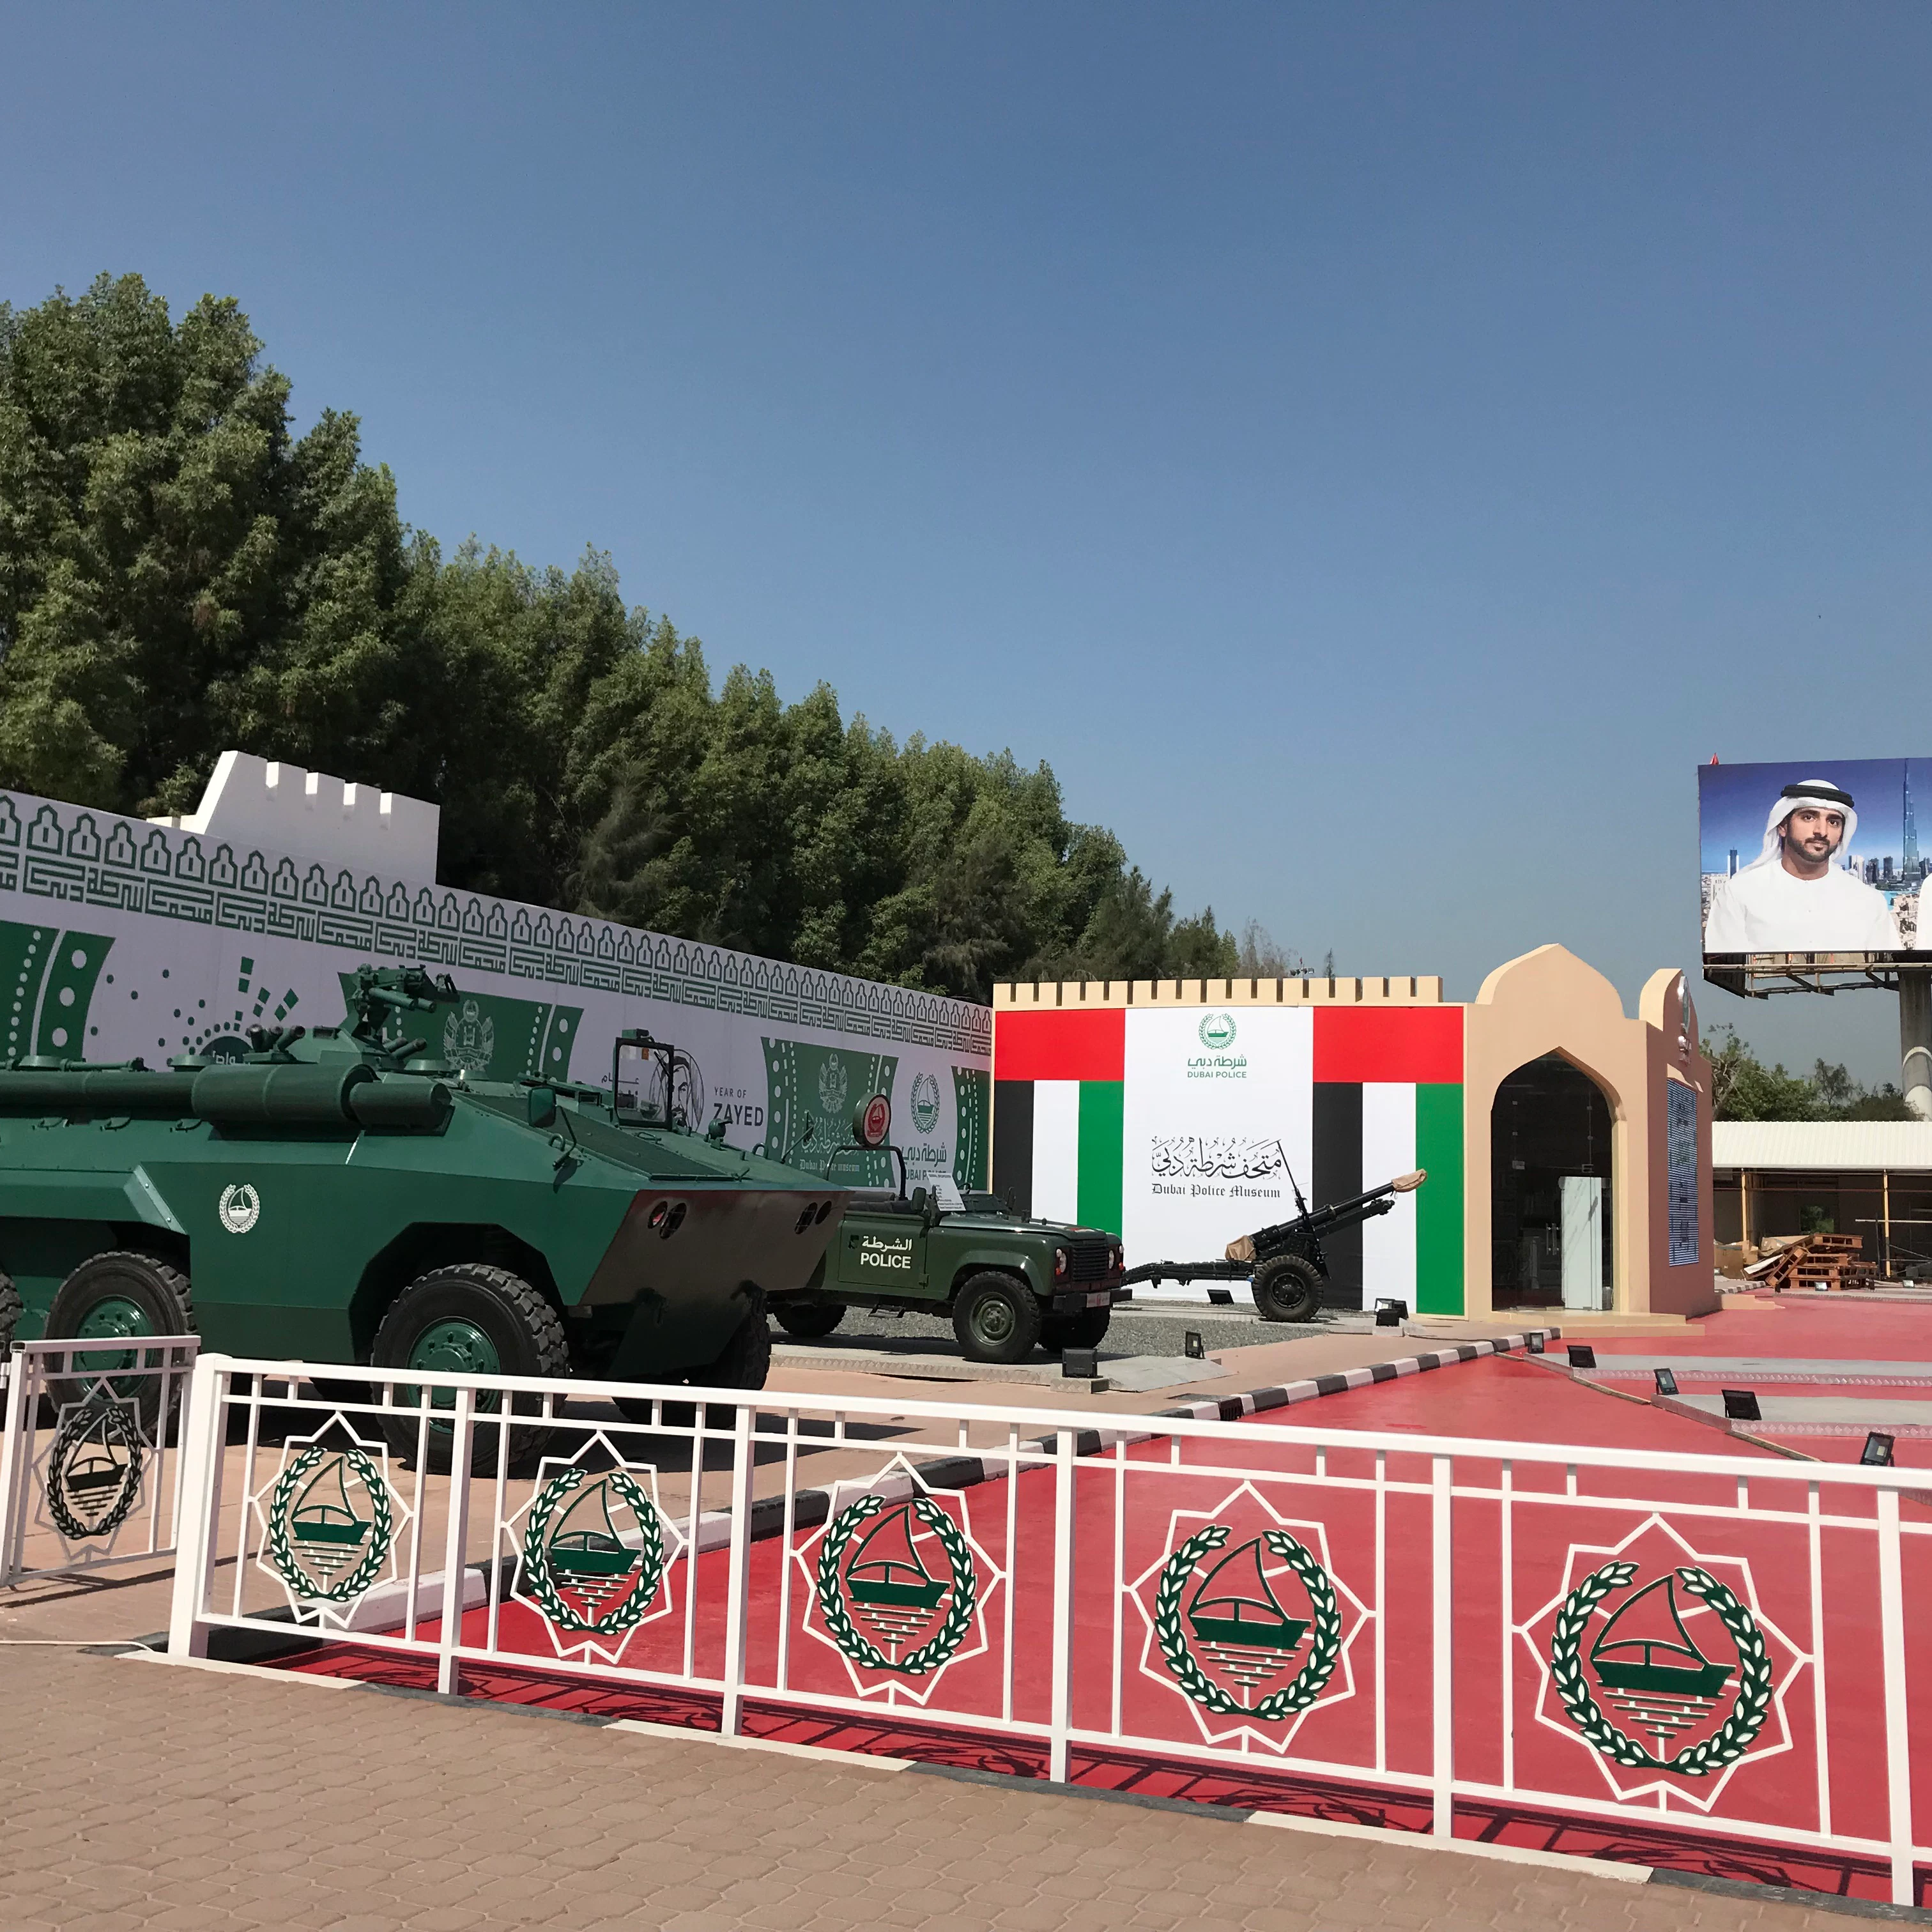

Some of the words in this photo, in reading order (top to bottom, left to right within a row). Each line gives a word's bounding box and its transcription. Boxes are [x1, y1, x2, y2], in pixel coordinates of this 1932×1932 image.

[1187, 1057, 1213, 1070] دبي
[1214, 1054, 1247, 1070] شرطة
[714, 1086, 734, 1098] YEAR
[737, 1088, 747, 1098] OF
[713, 1103, 764, 1127] ZAYED
[921, 1142, 947, 1167] شرطة
[799, 1159, 818, 1170] Dubai
[905, 1169, 921, 1181] UBAI
[1151, 1183, 1186, 1195] Dubai
[1190, 1183, 1225, 1197] Police
[1229, 1184, 1281, 1198] Museum
[862, 1235, 912, 1252] الشرطة
[860, 1252, 912, 1269] POLICE
